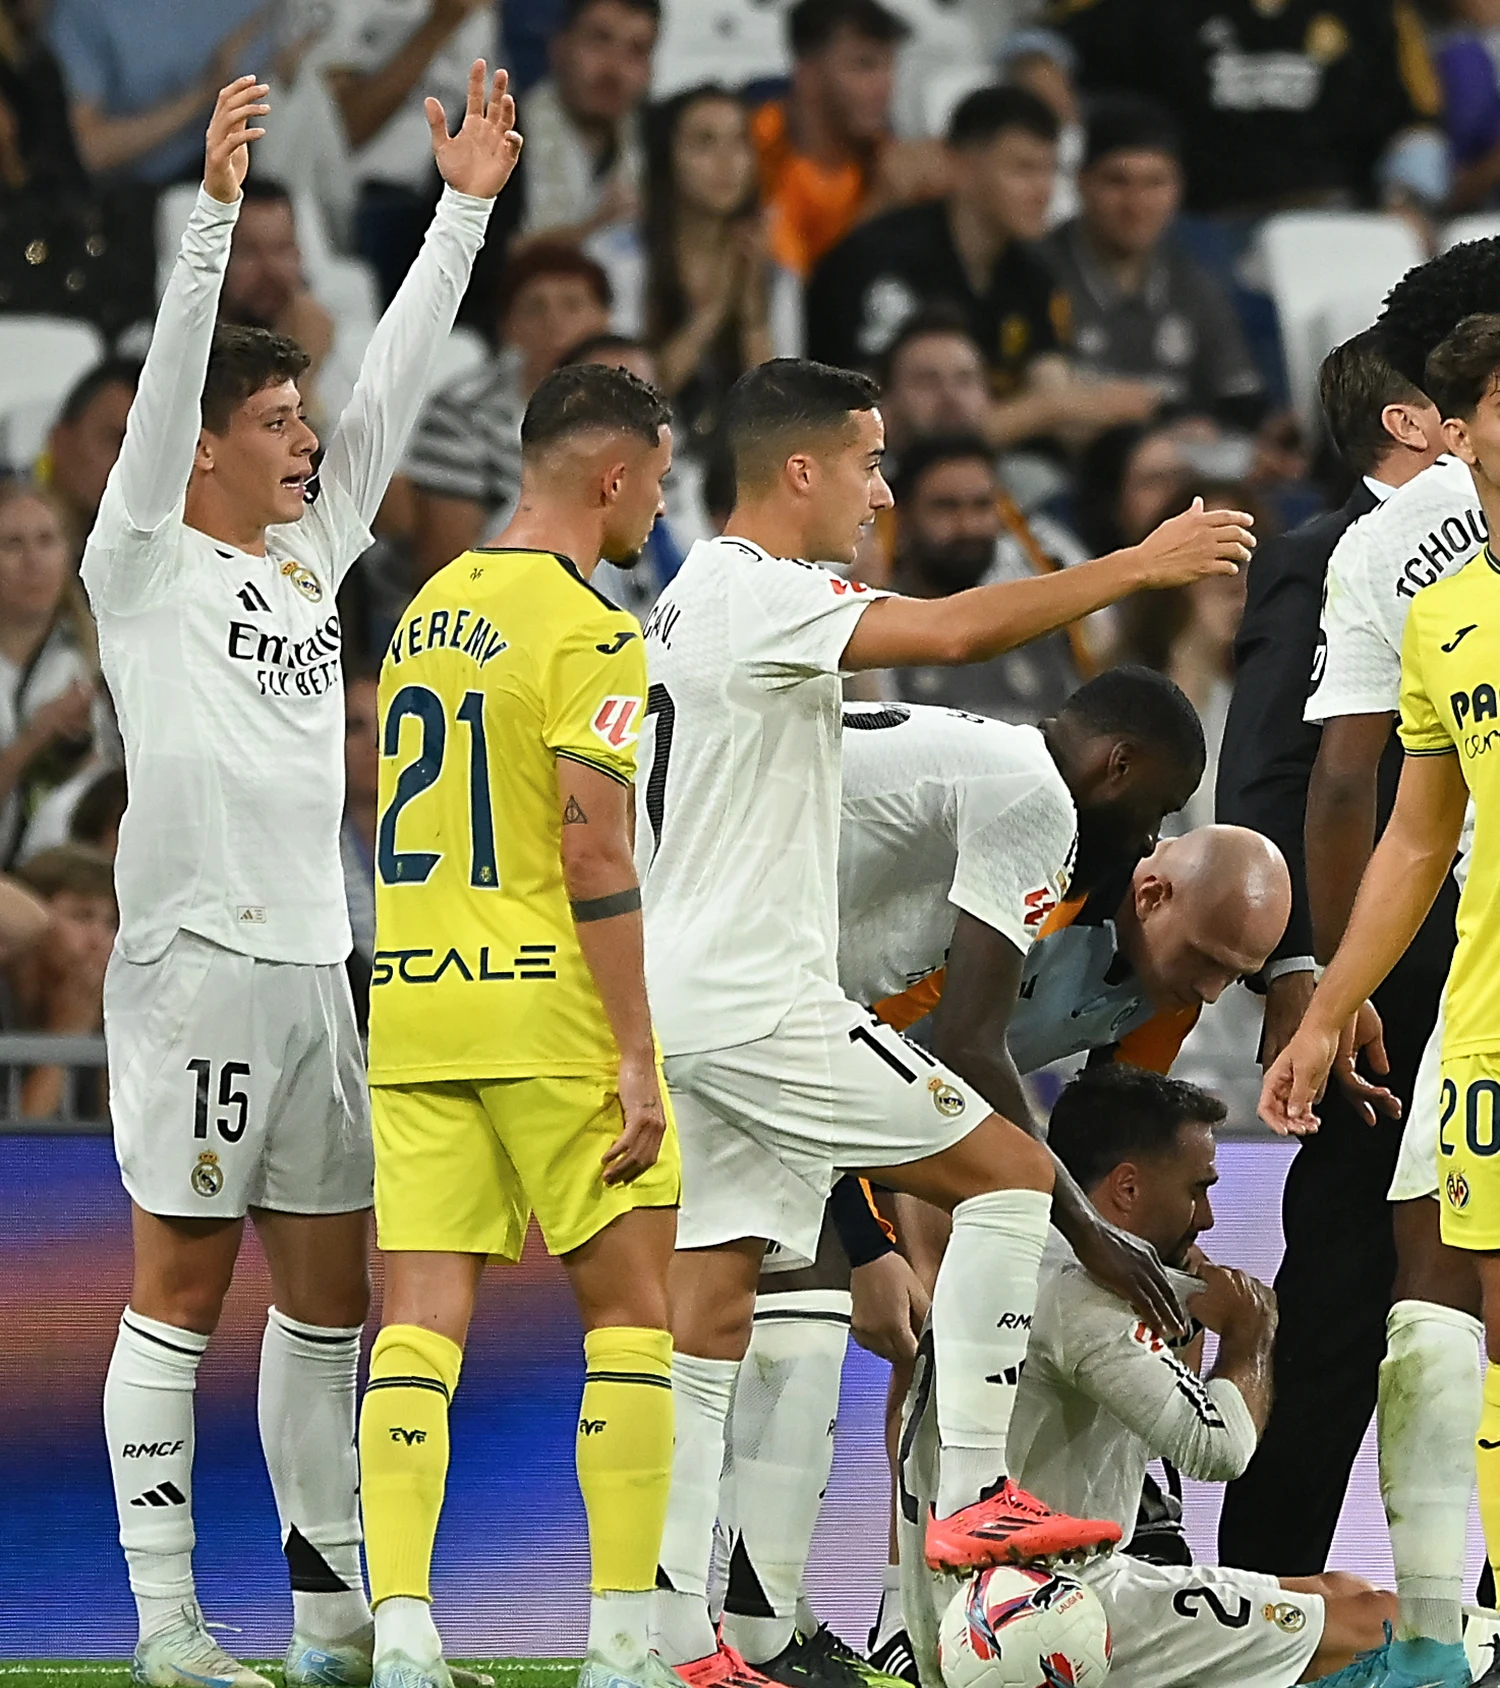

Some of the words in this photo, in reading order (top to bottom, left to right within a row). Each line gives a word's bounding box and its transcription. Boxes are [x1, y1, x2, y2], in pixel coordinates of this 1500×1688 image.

[1396, 509, 1489, 598] TCHOU
[228, 615, 341, 668] Emirate
[391, 609, 507, 669] YEREMY
[295, 659, 339, 696] BET
[378, 685, 500, 888] 21
[372, 945, 557, 986] SCALE
[186, 1058, 251, 1144] 15
[122, 1440, 185, 1459] RMCF
[1173, 1586, 1251, 1629] 2
